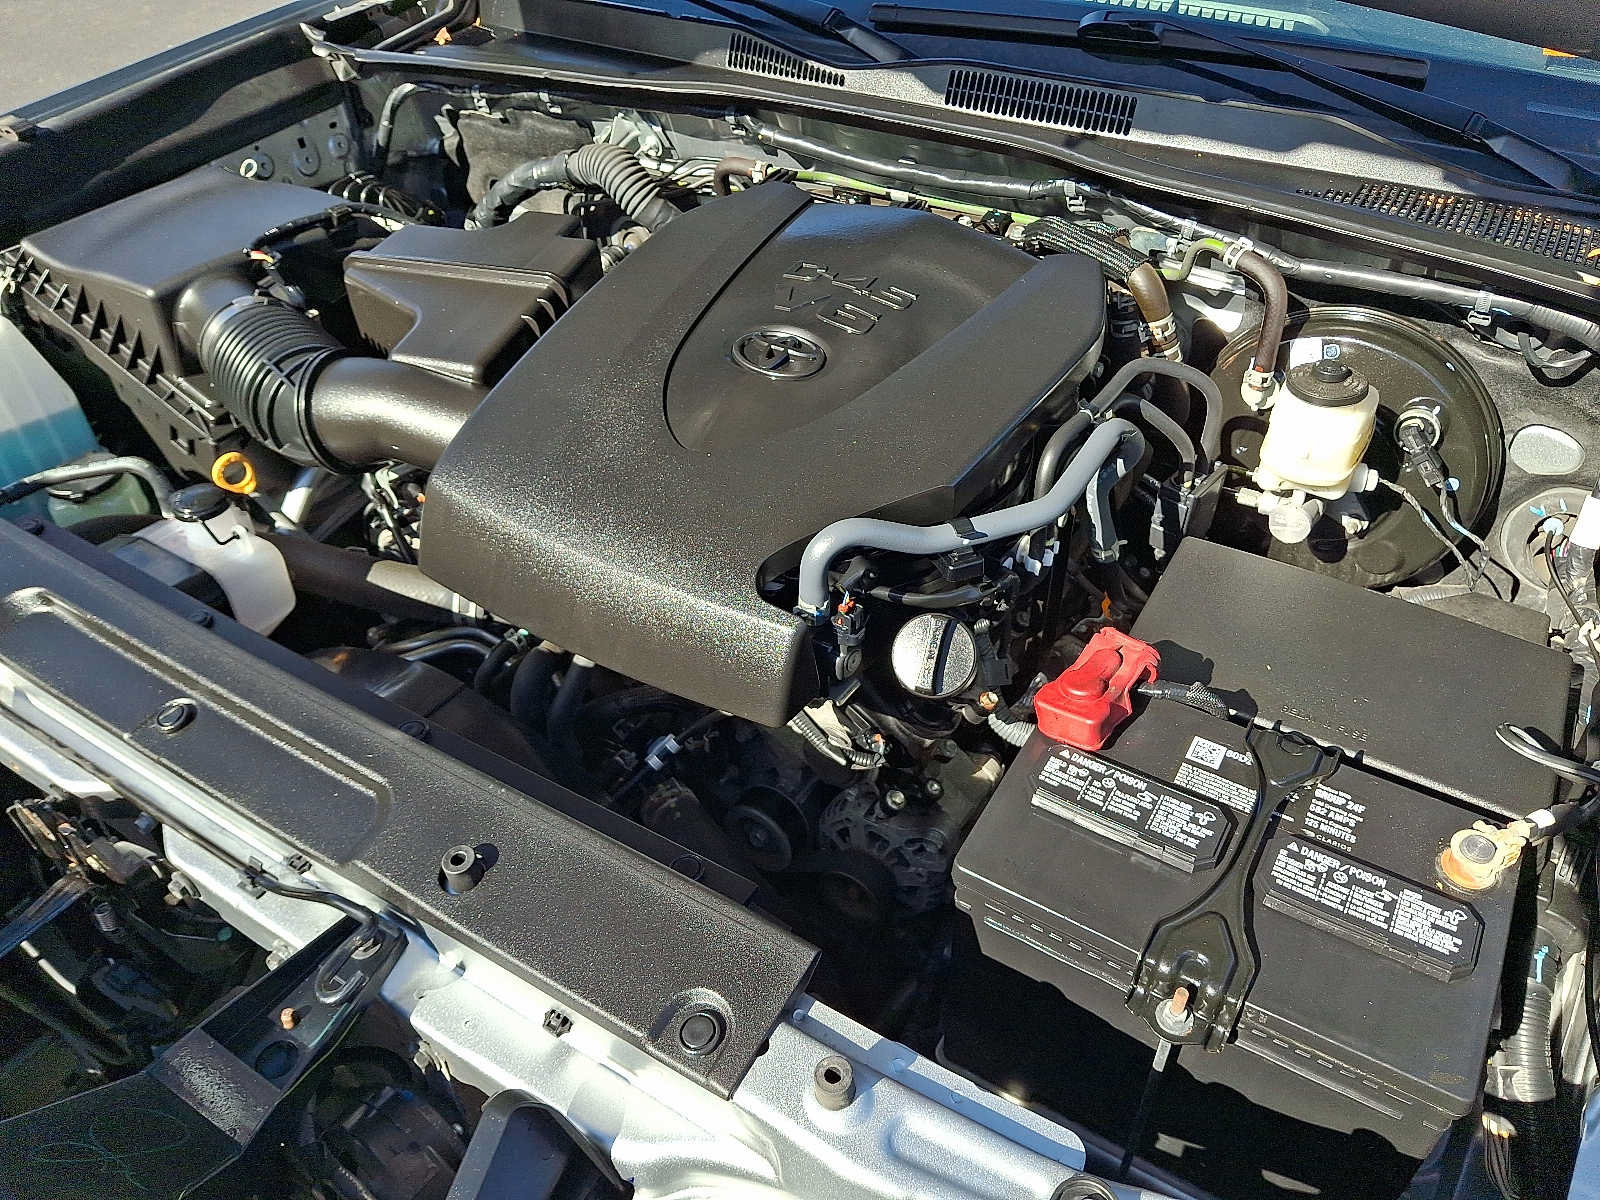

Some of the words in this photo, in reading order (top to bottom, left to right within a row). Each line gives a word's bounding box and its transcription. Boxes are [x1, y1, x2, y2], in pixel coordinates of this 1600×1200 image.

[774, 284, 883, 334] V6
[1071, 753, 1107, 774] DANGER
[1113, 771, 1147, 790] POISON
[1315, 789, 1347, 805] GROUP
[1346, 801, 1366, 813] 24F
[1328, 811, 1356, 827] AMPS
[1316, 835, 1352, 852] CLARIOS
[1319, 823, 1357, 843] MINUTES
[1300, 846, 1340, 869] DANGER
[1349, 866, 1387, 888] POISON
